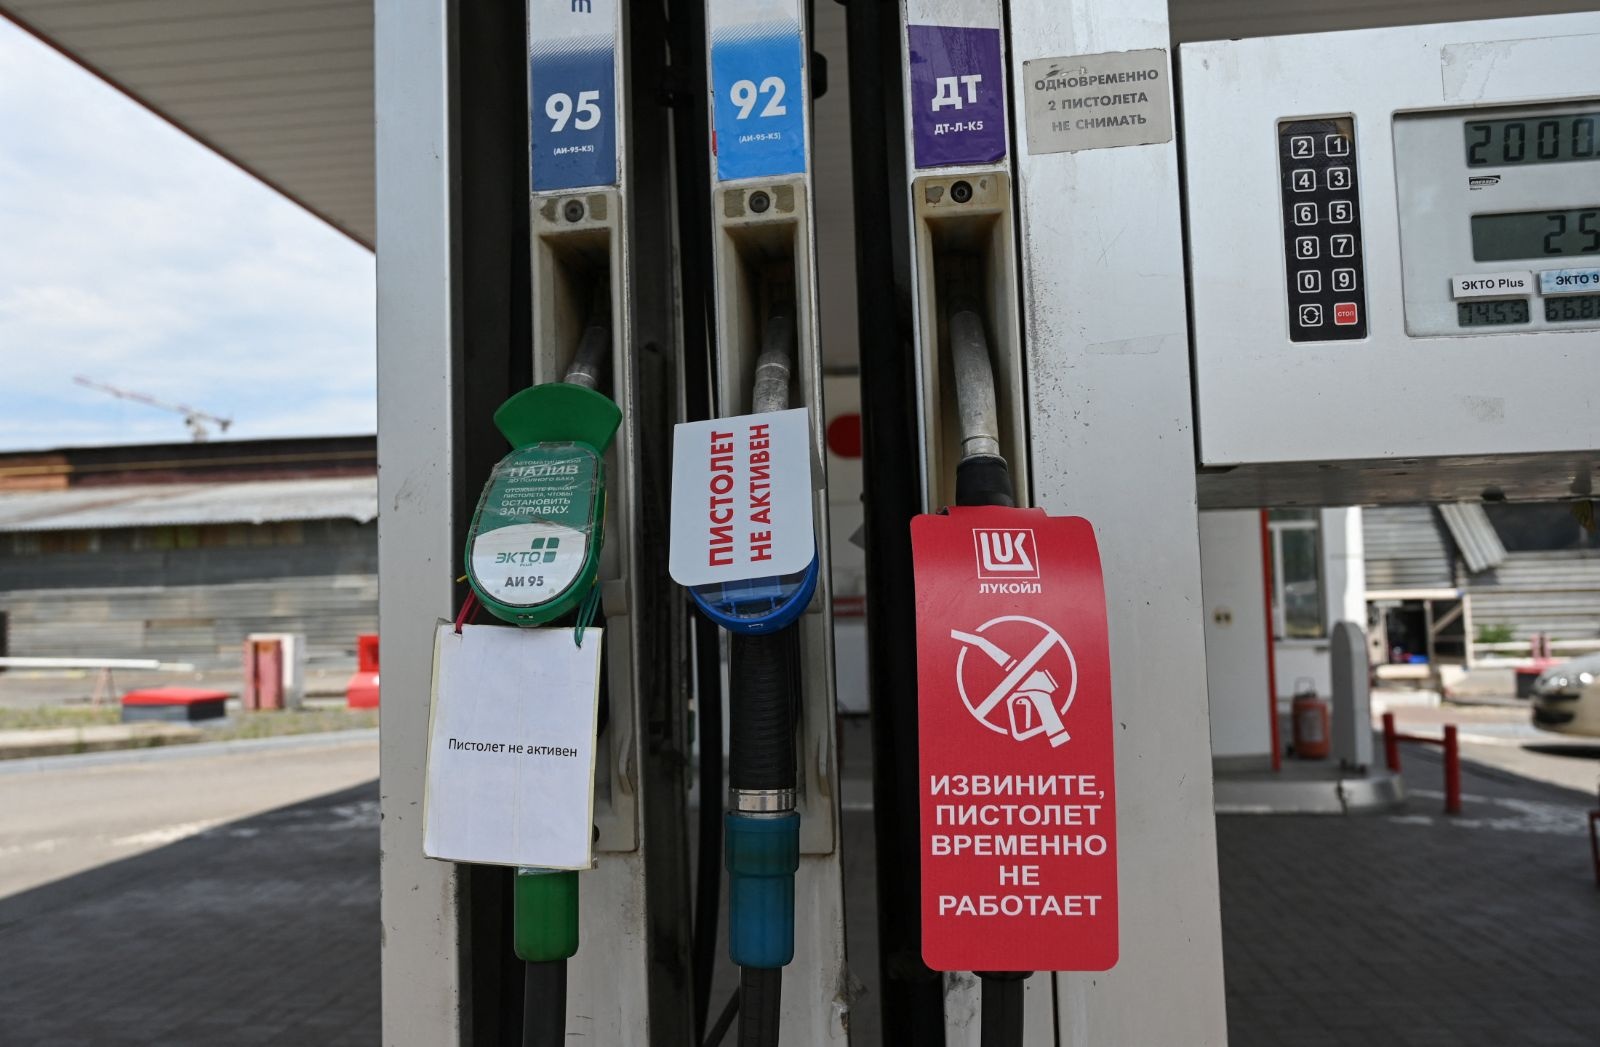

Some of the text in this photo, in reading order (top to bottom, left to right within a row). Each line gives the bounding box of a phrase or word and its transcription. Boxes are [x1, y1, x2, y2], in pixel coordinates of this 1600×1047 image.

[1034, 69, 1159, 91] ОДНОВРЕМЕННО
[730, 76, 786, 120] 92
[931, 74, 982, 111] ДТ
[1048, 92, 1148, 111] 2 ПИСТОЛЕТА
[545, 90, 601, 132] 95
[934, 121, 984, 135] ДТ-Л-К5
[1052, 114, 1147, 132] НЕ СНИМАТЬ
[738, 132, 781, 144] (АИ-95-К5)
[1297, 138, 1341, 155] 2 1
[553, 144, 594, 156] (АИ-95-К5)
[1299, 171, 1345, 188] 4 3
[1300, 205, 1346, 221] 6 5
[1302, 239, 1347, 255] 8 7
[1304, 273, 1349, 289] 0 9
[1462, 278, 1524, 290] ЭКТО Plus
[1556, 274, 1589, 286] ЭКТО
[510, 465, 579, 477] НАЛИВ
[709, 430, 734, 567] ПИСТОЛЕТ
[749, 423, 772, 562] НЕ АКТИВЕН
[499, 505, 569, 516] ЗАПРАВКУ.
[501, 498, 571, 507] ОСТАНОВИТЬ
[495, 551, 541, 564] ЭКТО
[504, 575, 544, 587] АИ 95
[979, 580, 1042, 595] ЛУКОЙЛ
[448, 738, 578, 758] Пистолет не активен
[930, 774, 1106, 799] ИЗВИНИТЕ,
[936, 804, 1102, 826] ПИСТОЛЕТ
[931, 834, 1108, 856] ВРЕМЕННО
[999, 865, 1040, 886] НЕ
[938, 894, 1103, 916] РАБОТАЕТ
